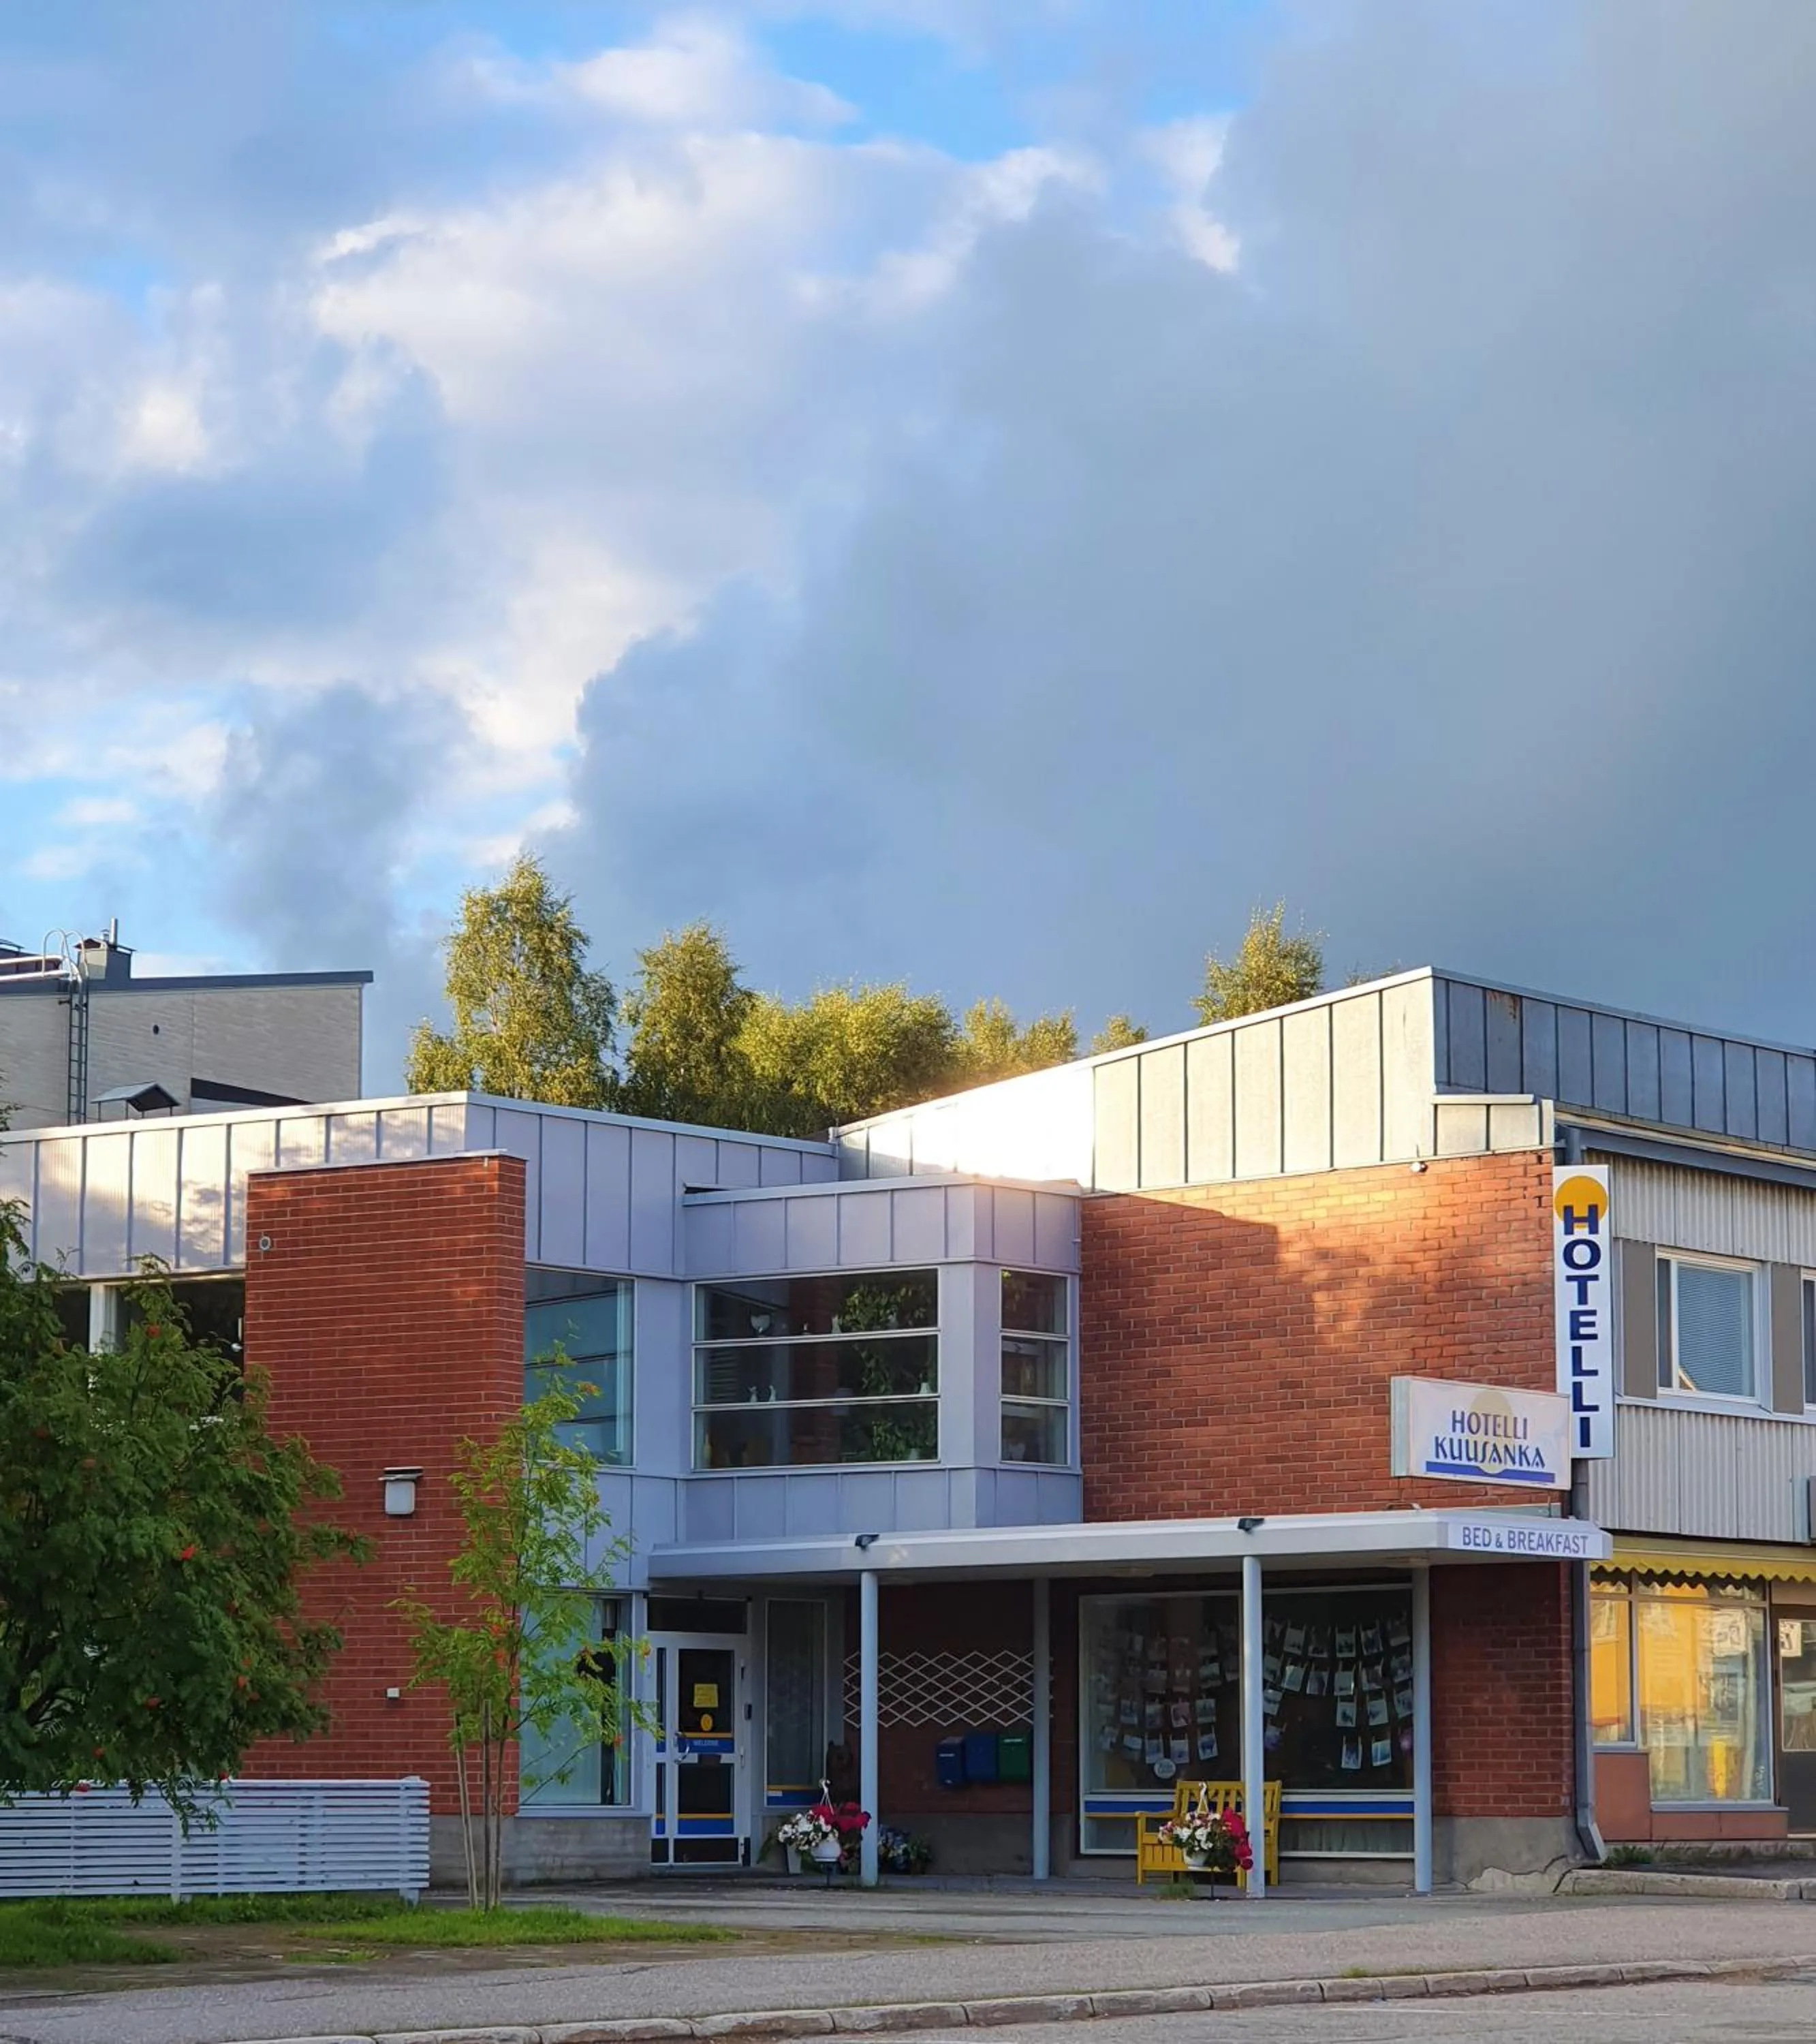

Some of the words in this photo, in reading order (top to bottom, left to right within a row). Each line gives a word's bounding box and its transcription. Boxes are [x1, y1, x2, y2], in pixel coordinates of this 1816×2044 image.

[1563, 1204, 1601, 1448] HOTELLI
[1452, 1410, 1527, 1440] HOTELLI
[1434, 1436, 1546, 1469] KUUSANKA
[1462, 1526, 1492, 1548] BED
[1494, 1532, 1503, 1549] &
[1507, 1530, 1588, 1554] BREAKFAST
